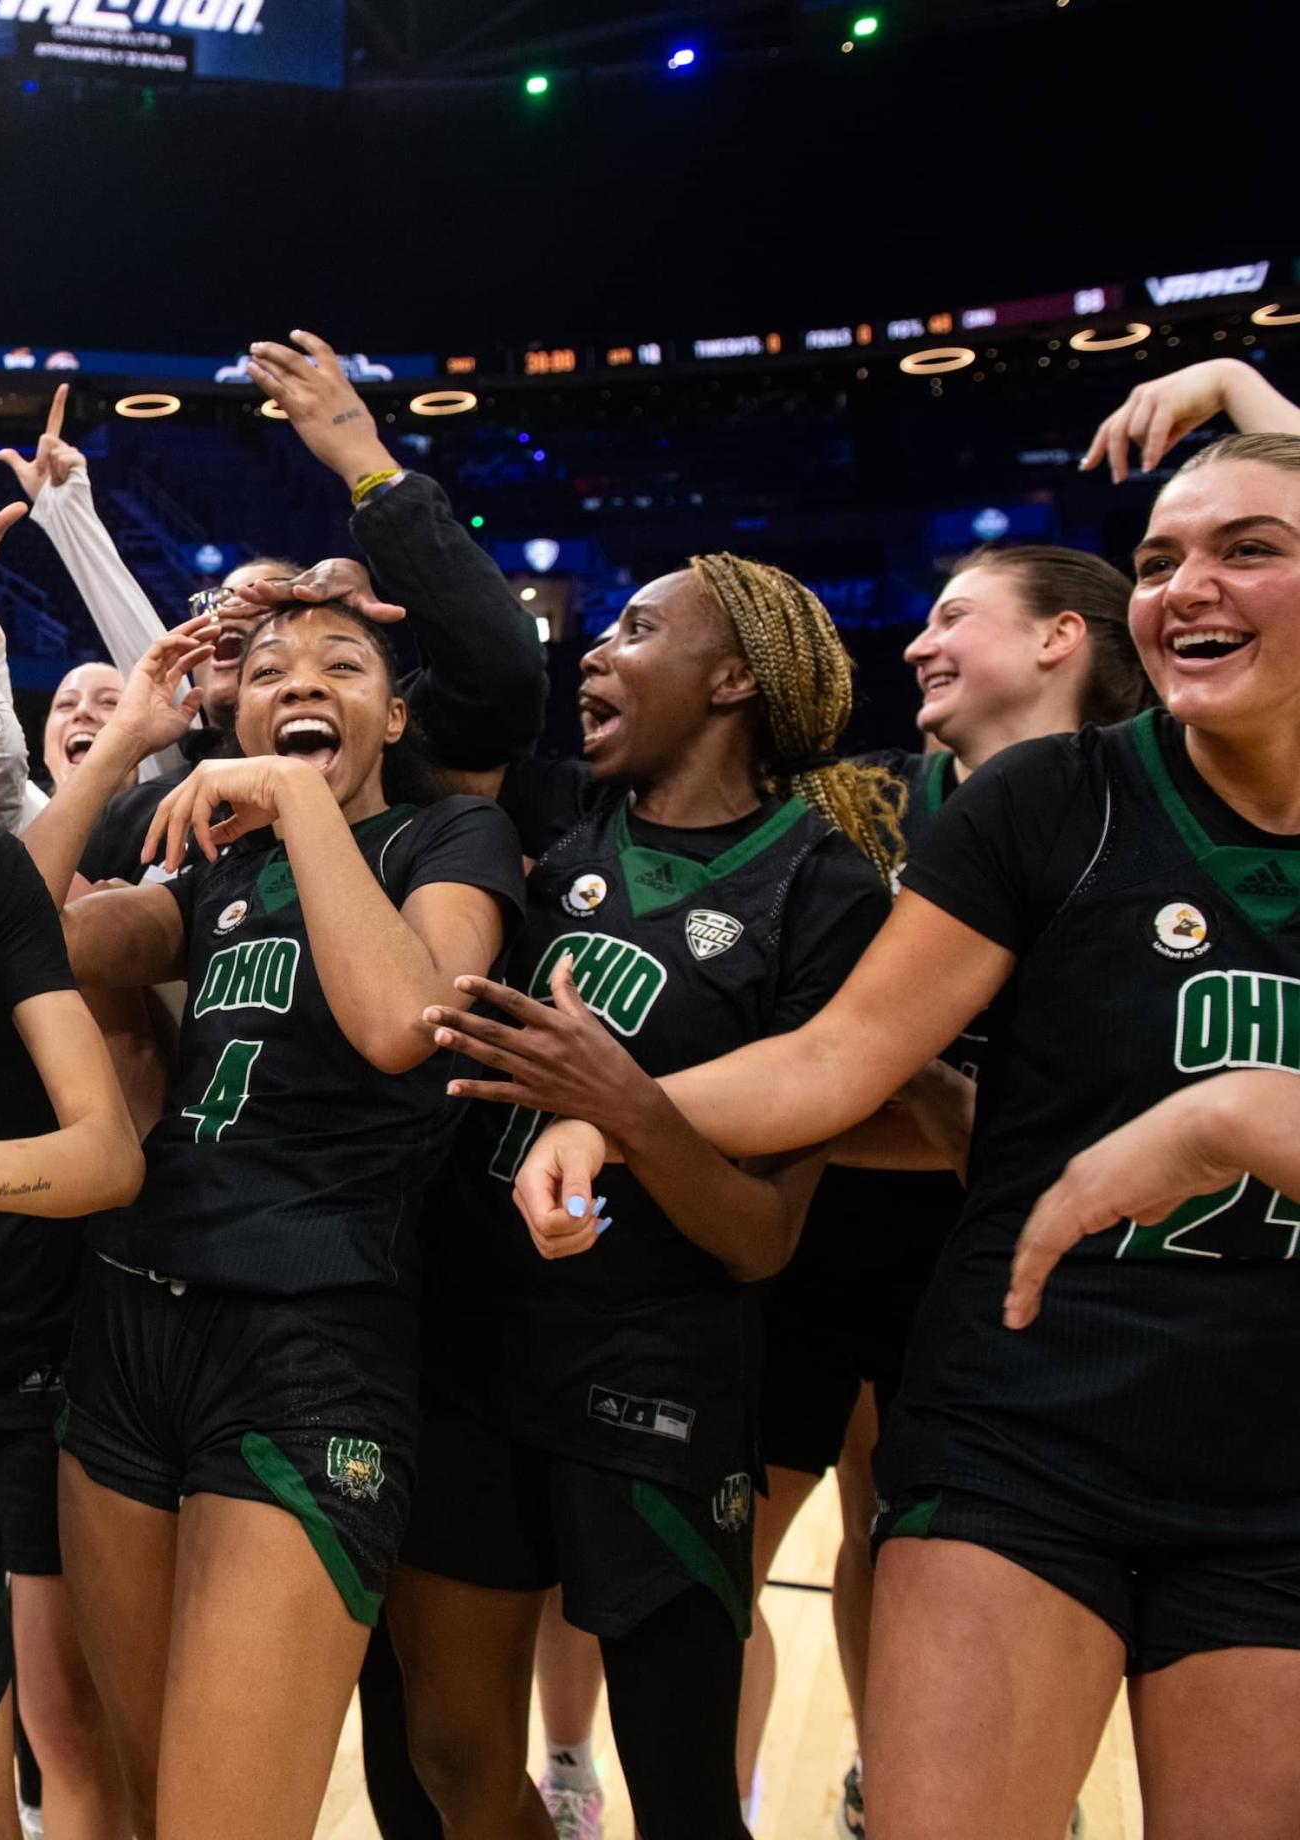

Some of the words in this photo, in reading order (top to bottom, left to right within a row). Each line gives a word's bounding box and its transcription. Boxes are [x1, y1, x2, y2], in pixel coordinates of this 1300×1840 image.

[193, 936, 301, 1019] OHIO
[689, 921, 736, 945] MAC
[528, 931, 668, 1038] OHIO
[180, 1038, 264, 1144] 4
